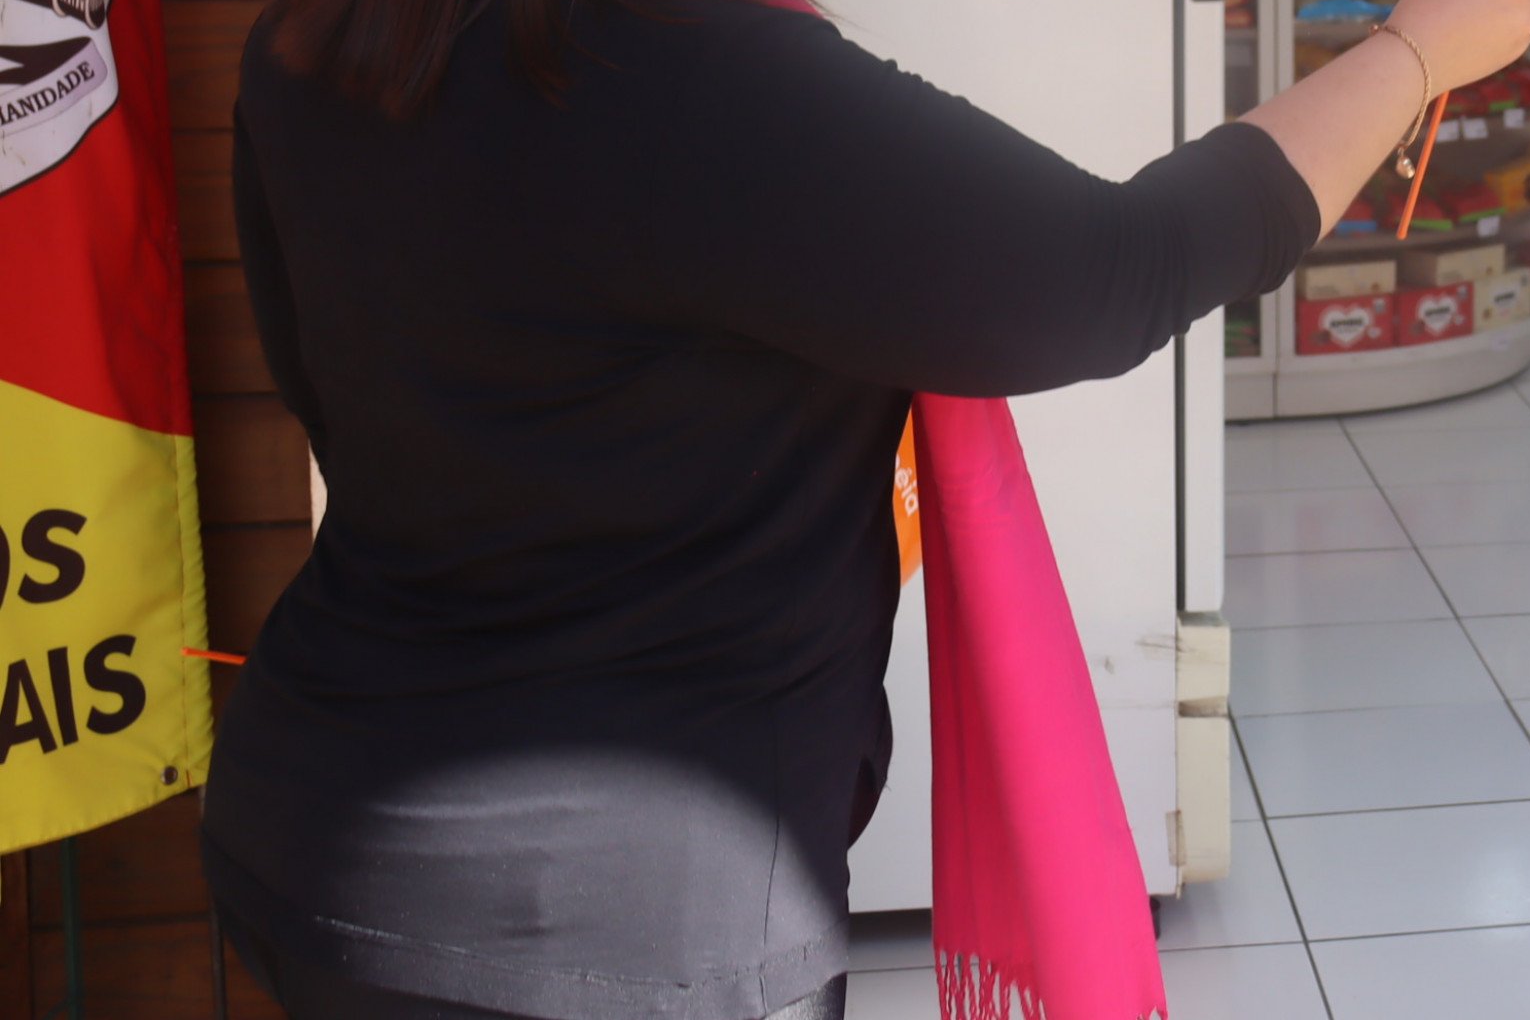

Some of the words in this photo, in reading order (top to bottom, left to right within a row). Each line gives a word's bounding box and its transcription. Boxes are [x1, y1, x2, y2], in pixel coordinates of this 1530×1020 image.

[0, 60, 96, 126] ANIDADE
[894, 452, 920, 518] éia
[0, 508, 88, 605] S
